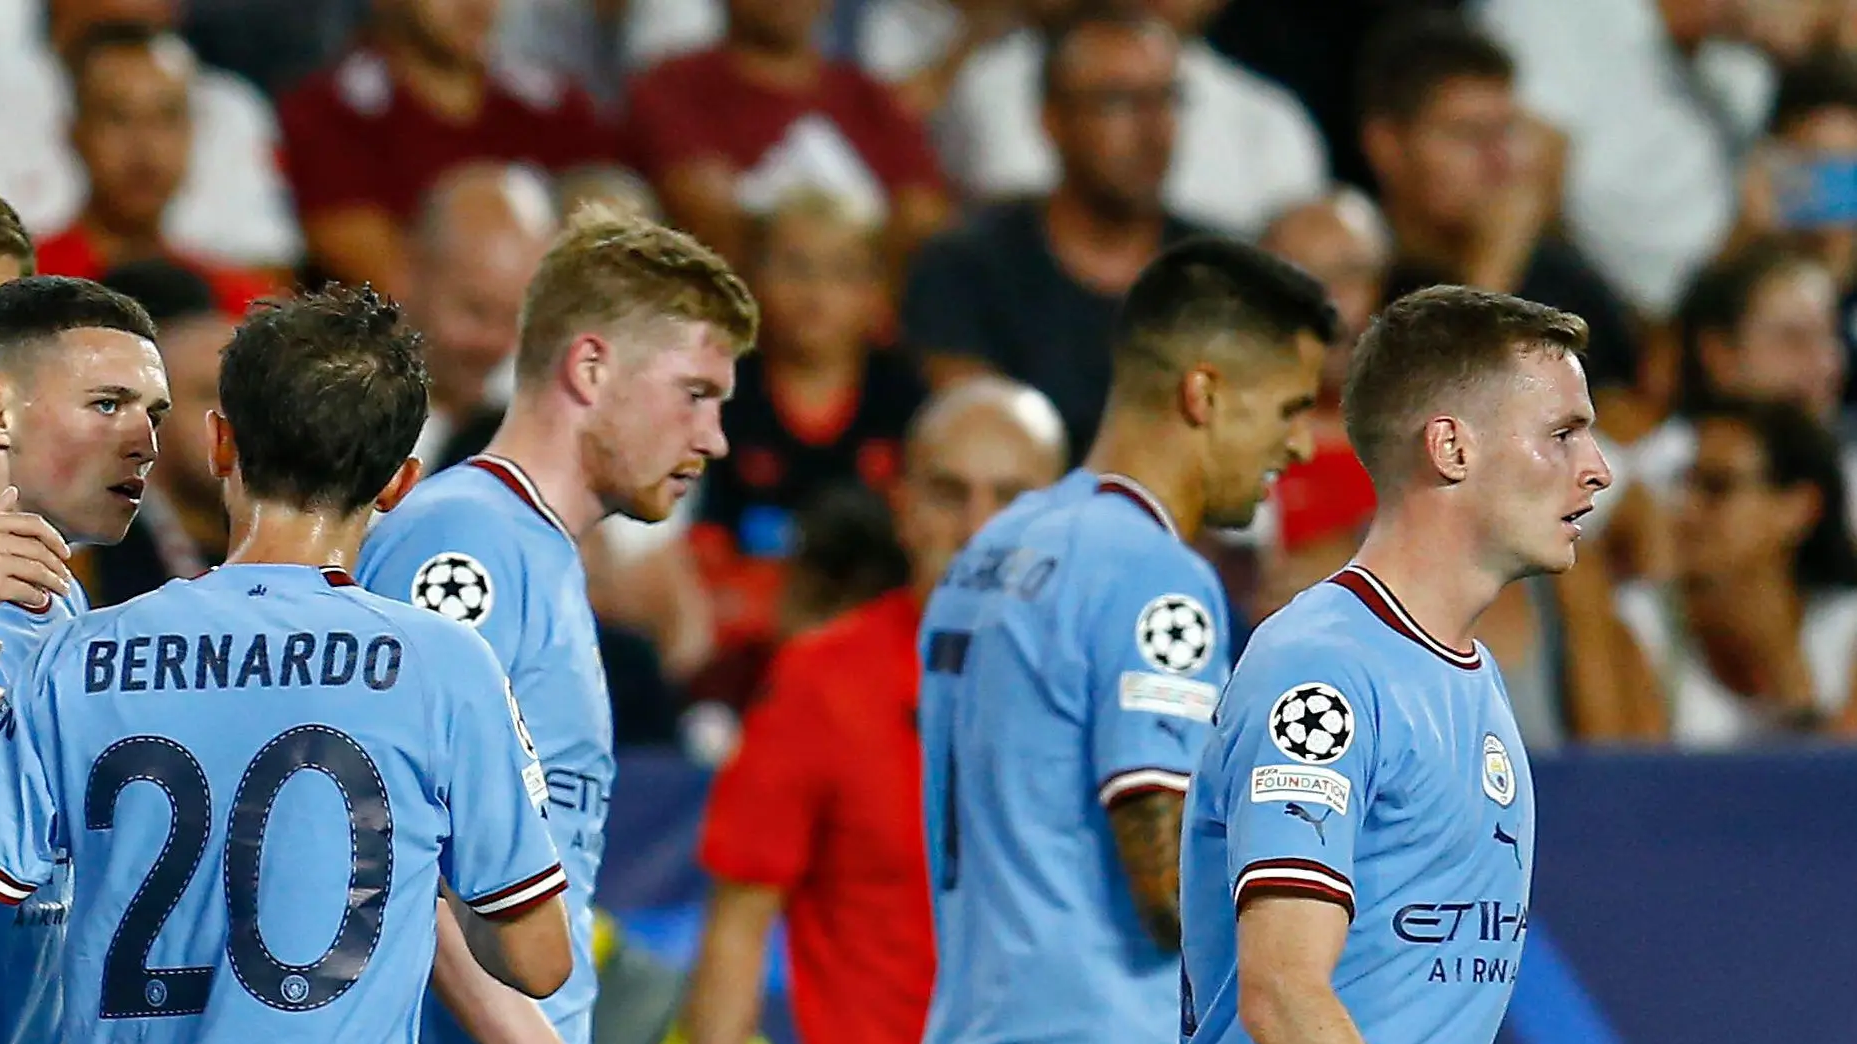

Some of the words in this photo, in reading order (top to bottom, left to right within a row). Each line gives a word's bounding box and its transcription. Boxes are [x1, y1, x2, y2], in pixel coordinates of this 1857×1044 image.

[85, 631, 404, 694] BERNARDO
[1255, 776, 1347, 802] FOUNDATION
[85, 721, 395, 1020] 20
